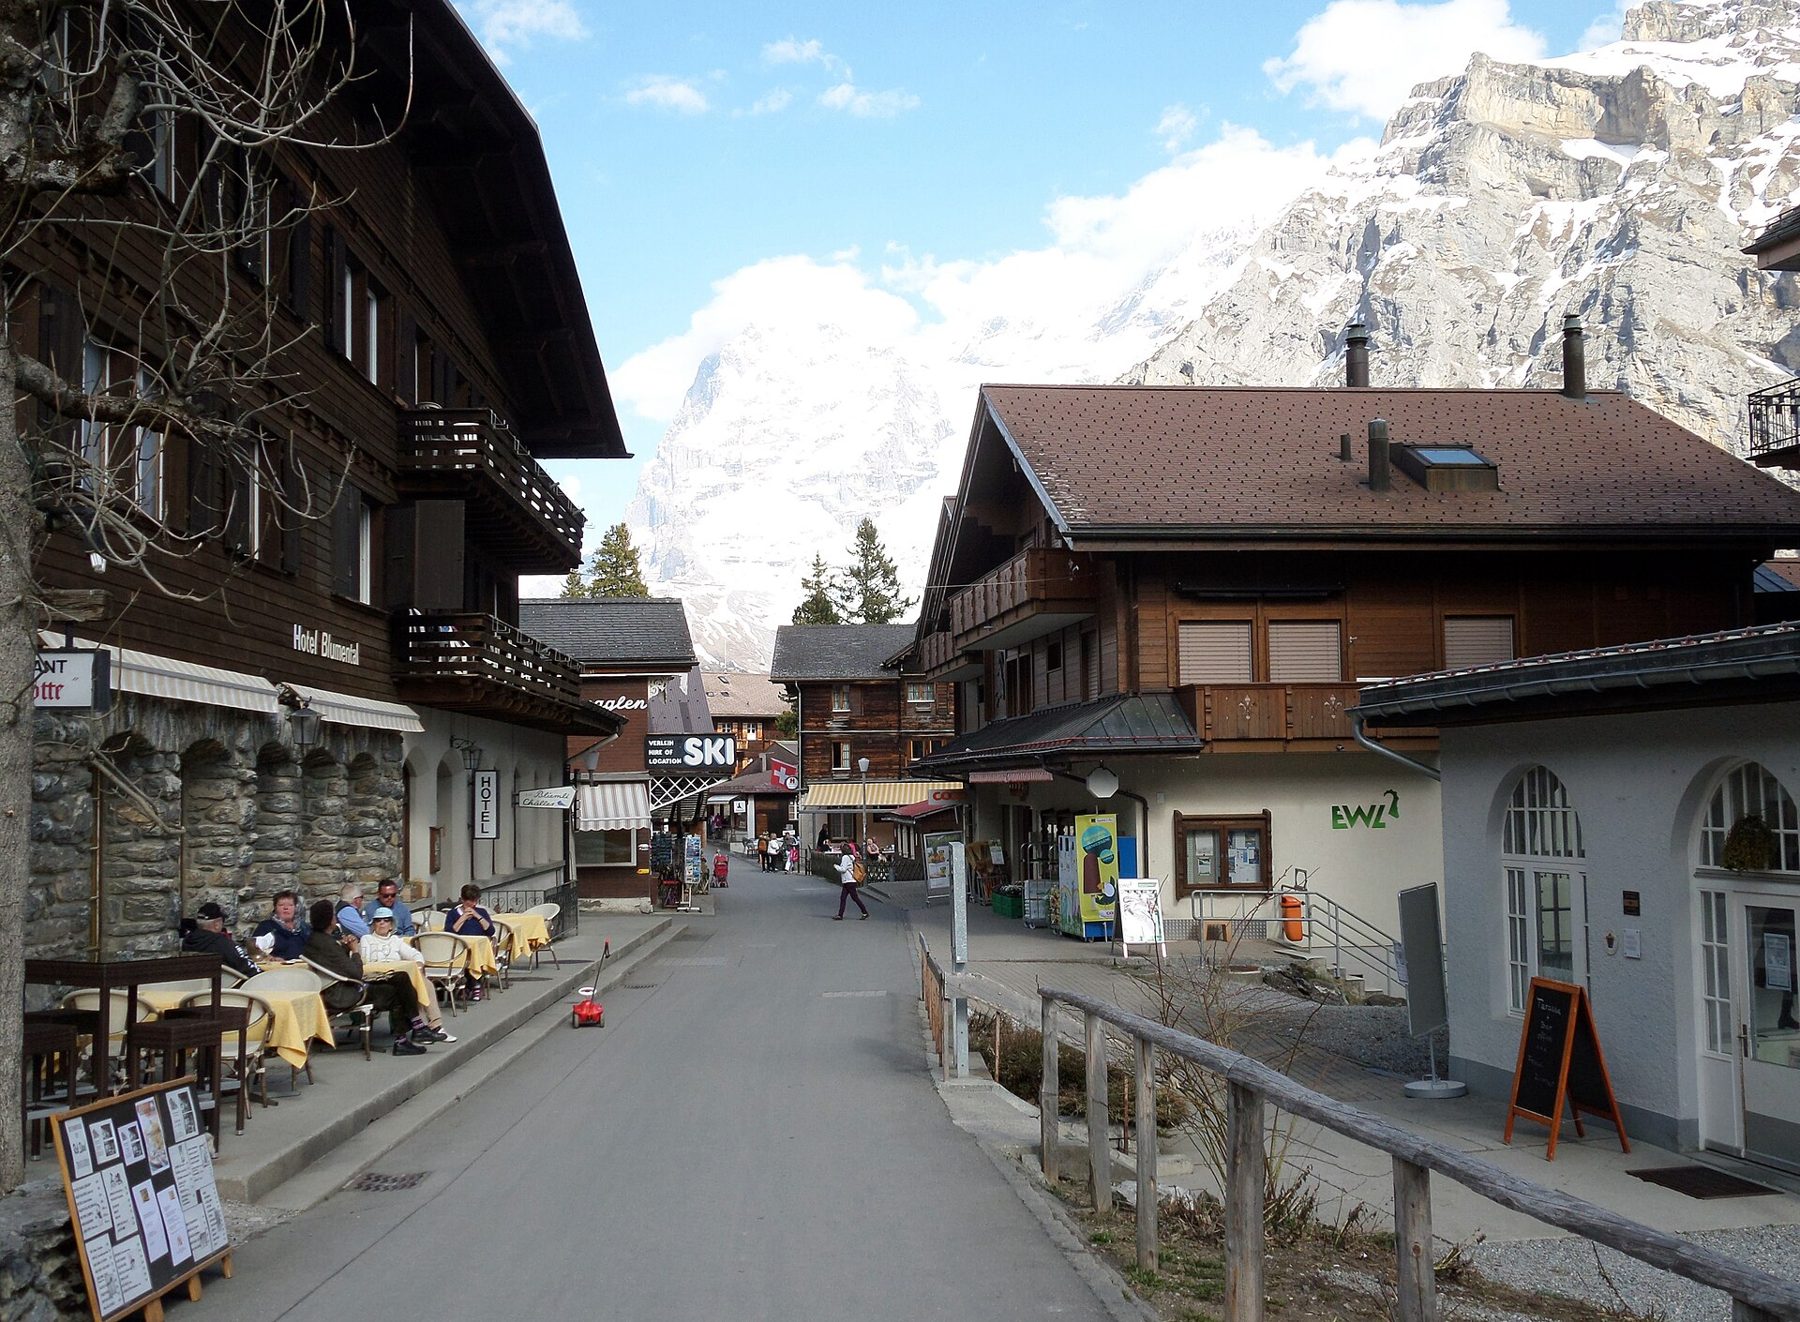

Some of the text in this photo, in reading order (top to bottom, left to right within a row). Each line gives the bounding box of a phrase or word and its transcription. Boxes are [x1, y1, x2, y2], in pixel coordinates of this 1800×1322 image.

[293, 624, 359, 665] Hotel Blumental
[34, 660, 68, 673] ANT
[683, 737, 735, 766] SKI
[481, 776, 491, 834] HOTEL
[1331, 804, 1386, 830] EWL
